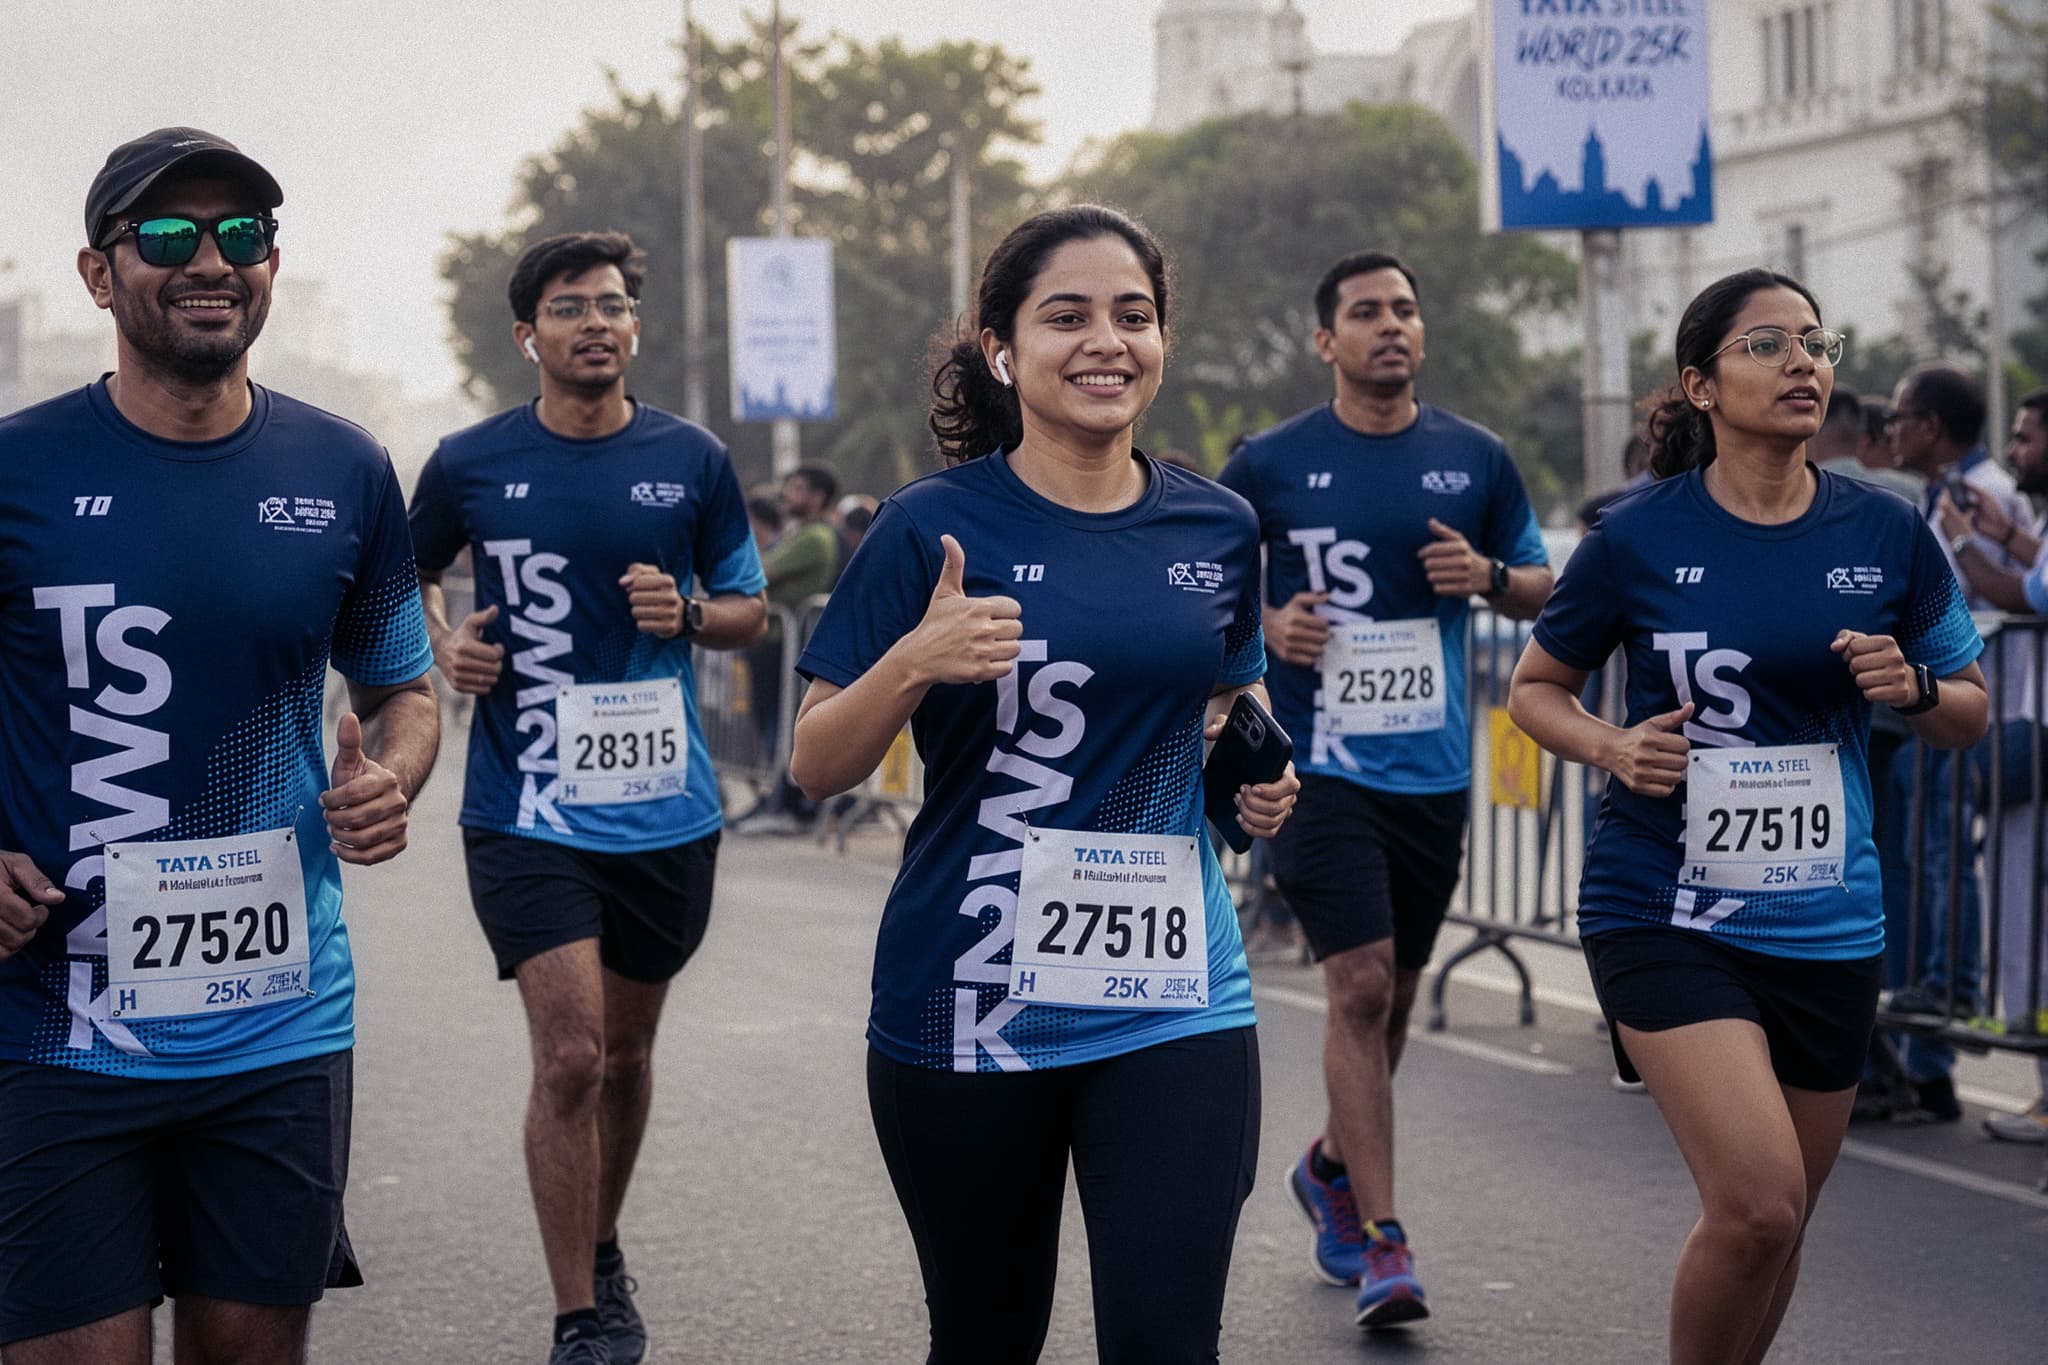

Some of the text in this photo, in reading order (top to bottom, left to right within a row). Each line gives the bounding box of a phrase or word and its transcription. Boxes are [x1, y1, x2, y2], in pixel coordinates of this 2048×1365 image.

[1518, 0, 1601, 17] TATA
[1338, 666, 1433, 703] 25228
[576, 729, 677, 771] 28315
[1729, 759, 1811, 773] TATA STEEL
[564, 784, 577, 798] H
[1706, 803, 1831, 853] 27519
[157, 849, 262, 873] TATA STEEL
[1074, 848, 1167, 865] TATA STEEL
[1692, 866, 1706, 880] H
[1763, 865, 1798, 884] 25K
[132, 902, 289, 969] 27520
[1037, 901, 1187, 959] 27518
[119, 989, 137, 1010] H
[205, 978, 253, 1005] 25K
[1019, 971, 1036, 992] H
[1103, 976, 1149, 999] 25K
